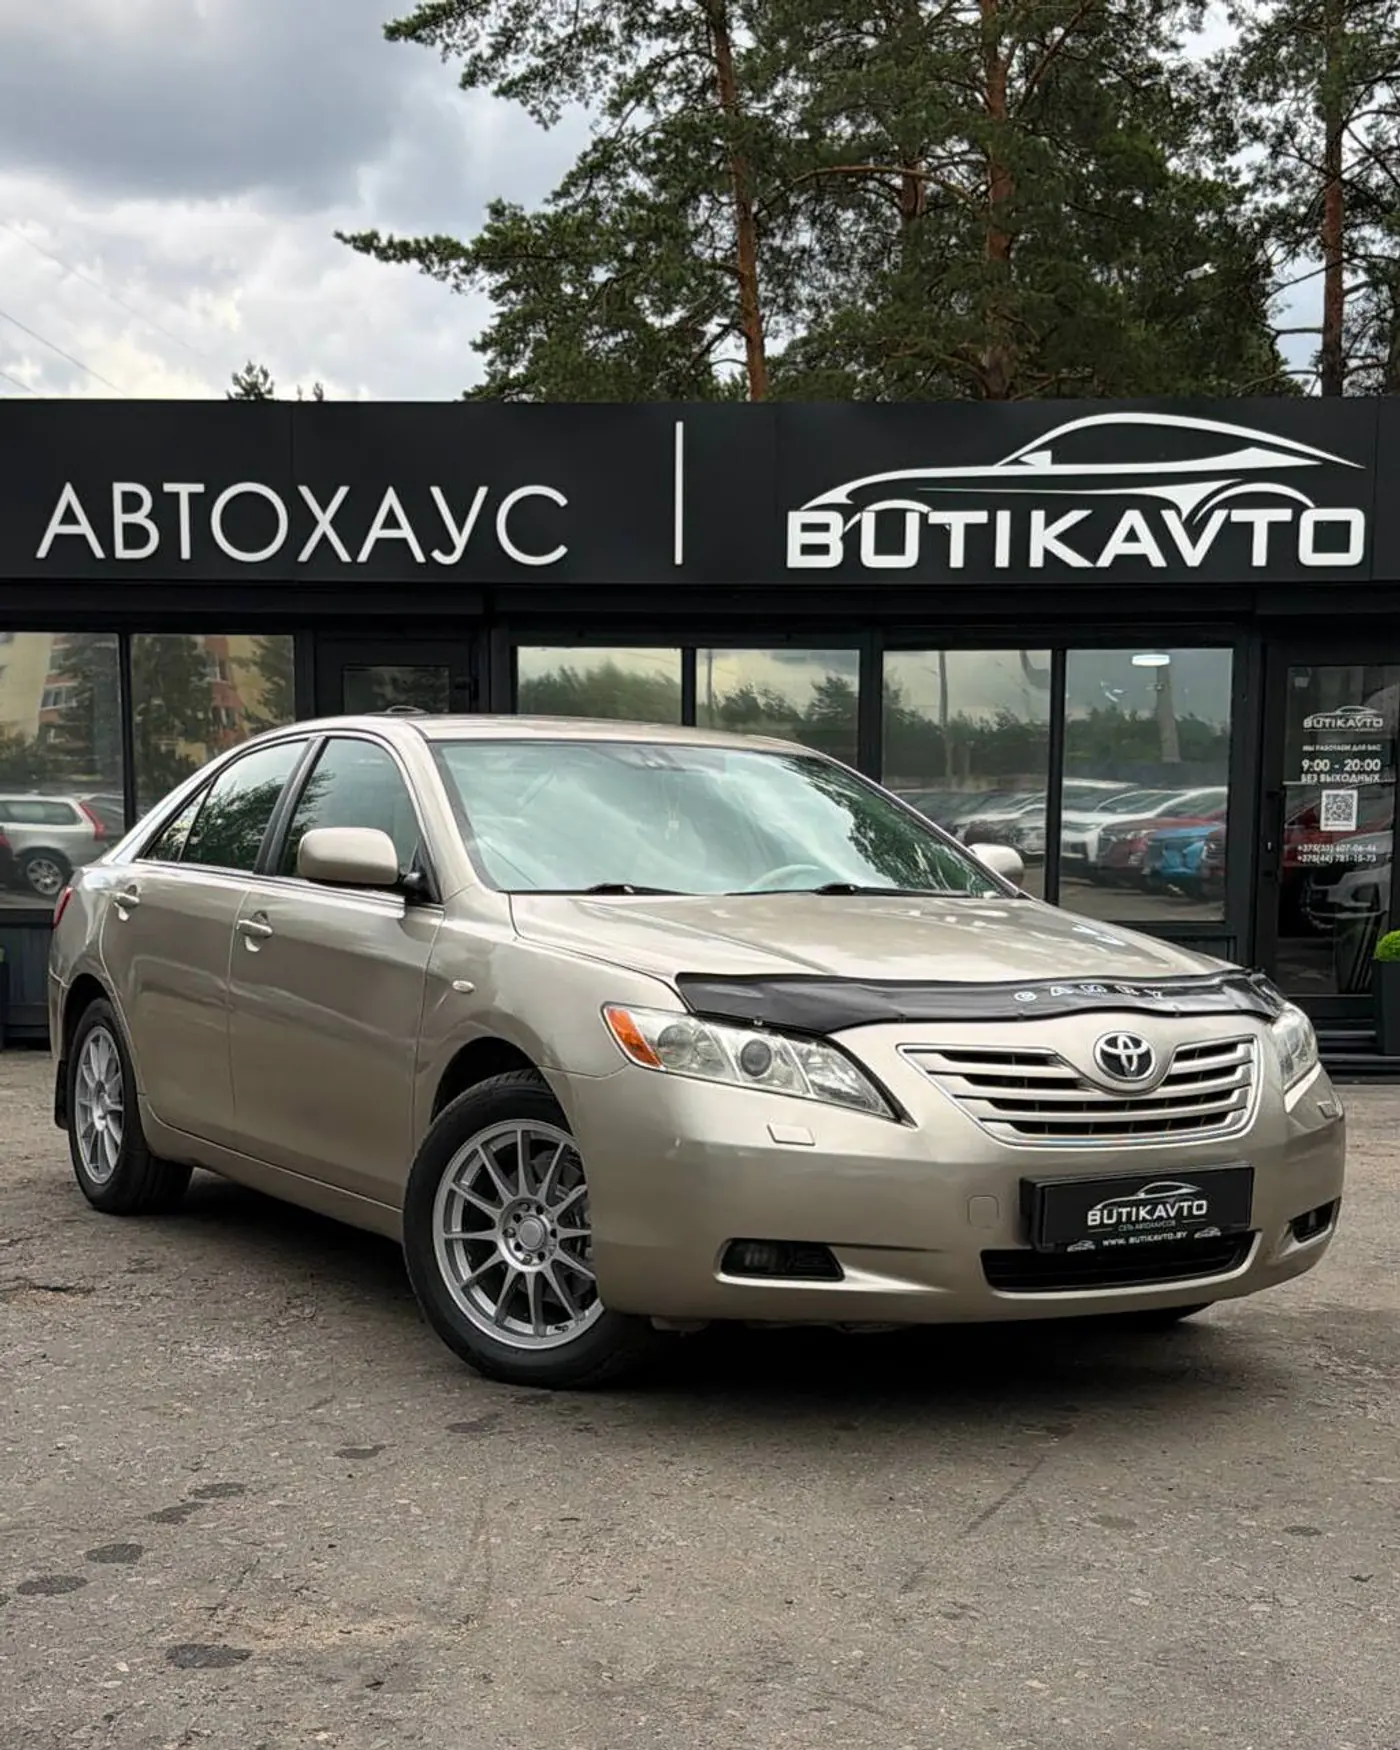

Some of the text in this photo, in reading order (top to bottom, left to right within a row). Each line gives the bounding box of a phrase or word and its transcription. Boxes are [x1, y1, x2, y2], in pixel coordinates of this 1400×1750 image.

[35, 482, 569, 566] АВТОХАУС
[786, 508, 1366, 568] BUTIKAVTO
[1303, 717, 1384, 729] BUTIKAVTO
[1301, 758, 1330, 772] 9:00
[1343, 758, 1381, 771] 20:00
[1301, 773, 1380, 783] БЕЗ ВЫХОДНЫХ
[1087, 1199, 1208, 1226] BUTIKAVTO
